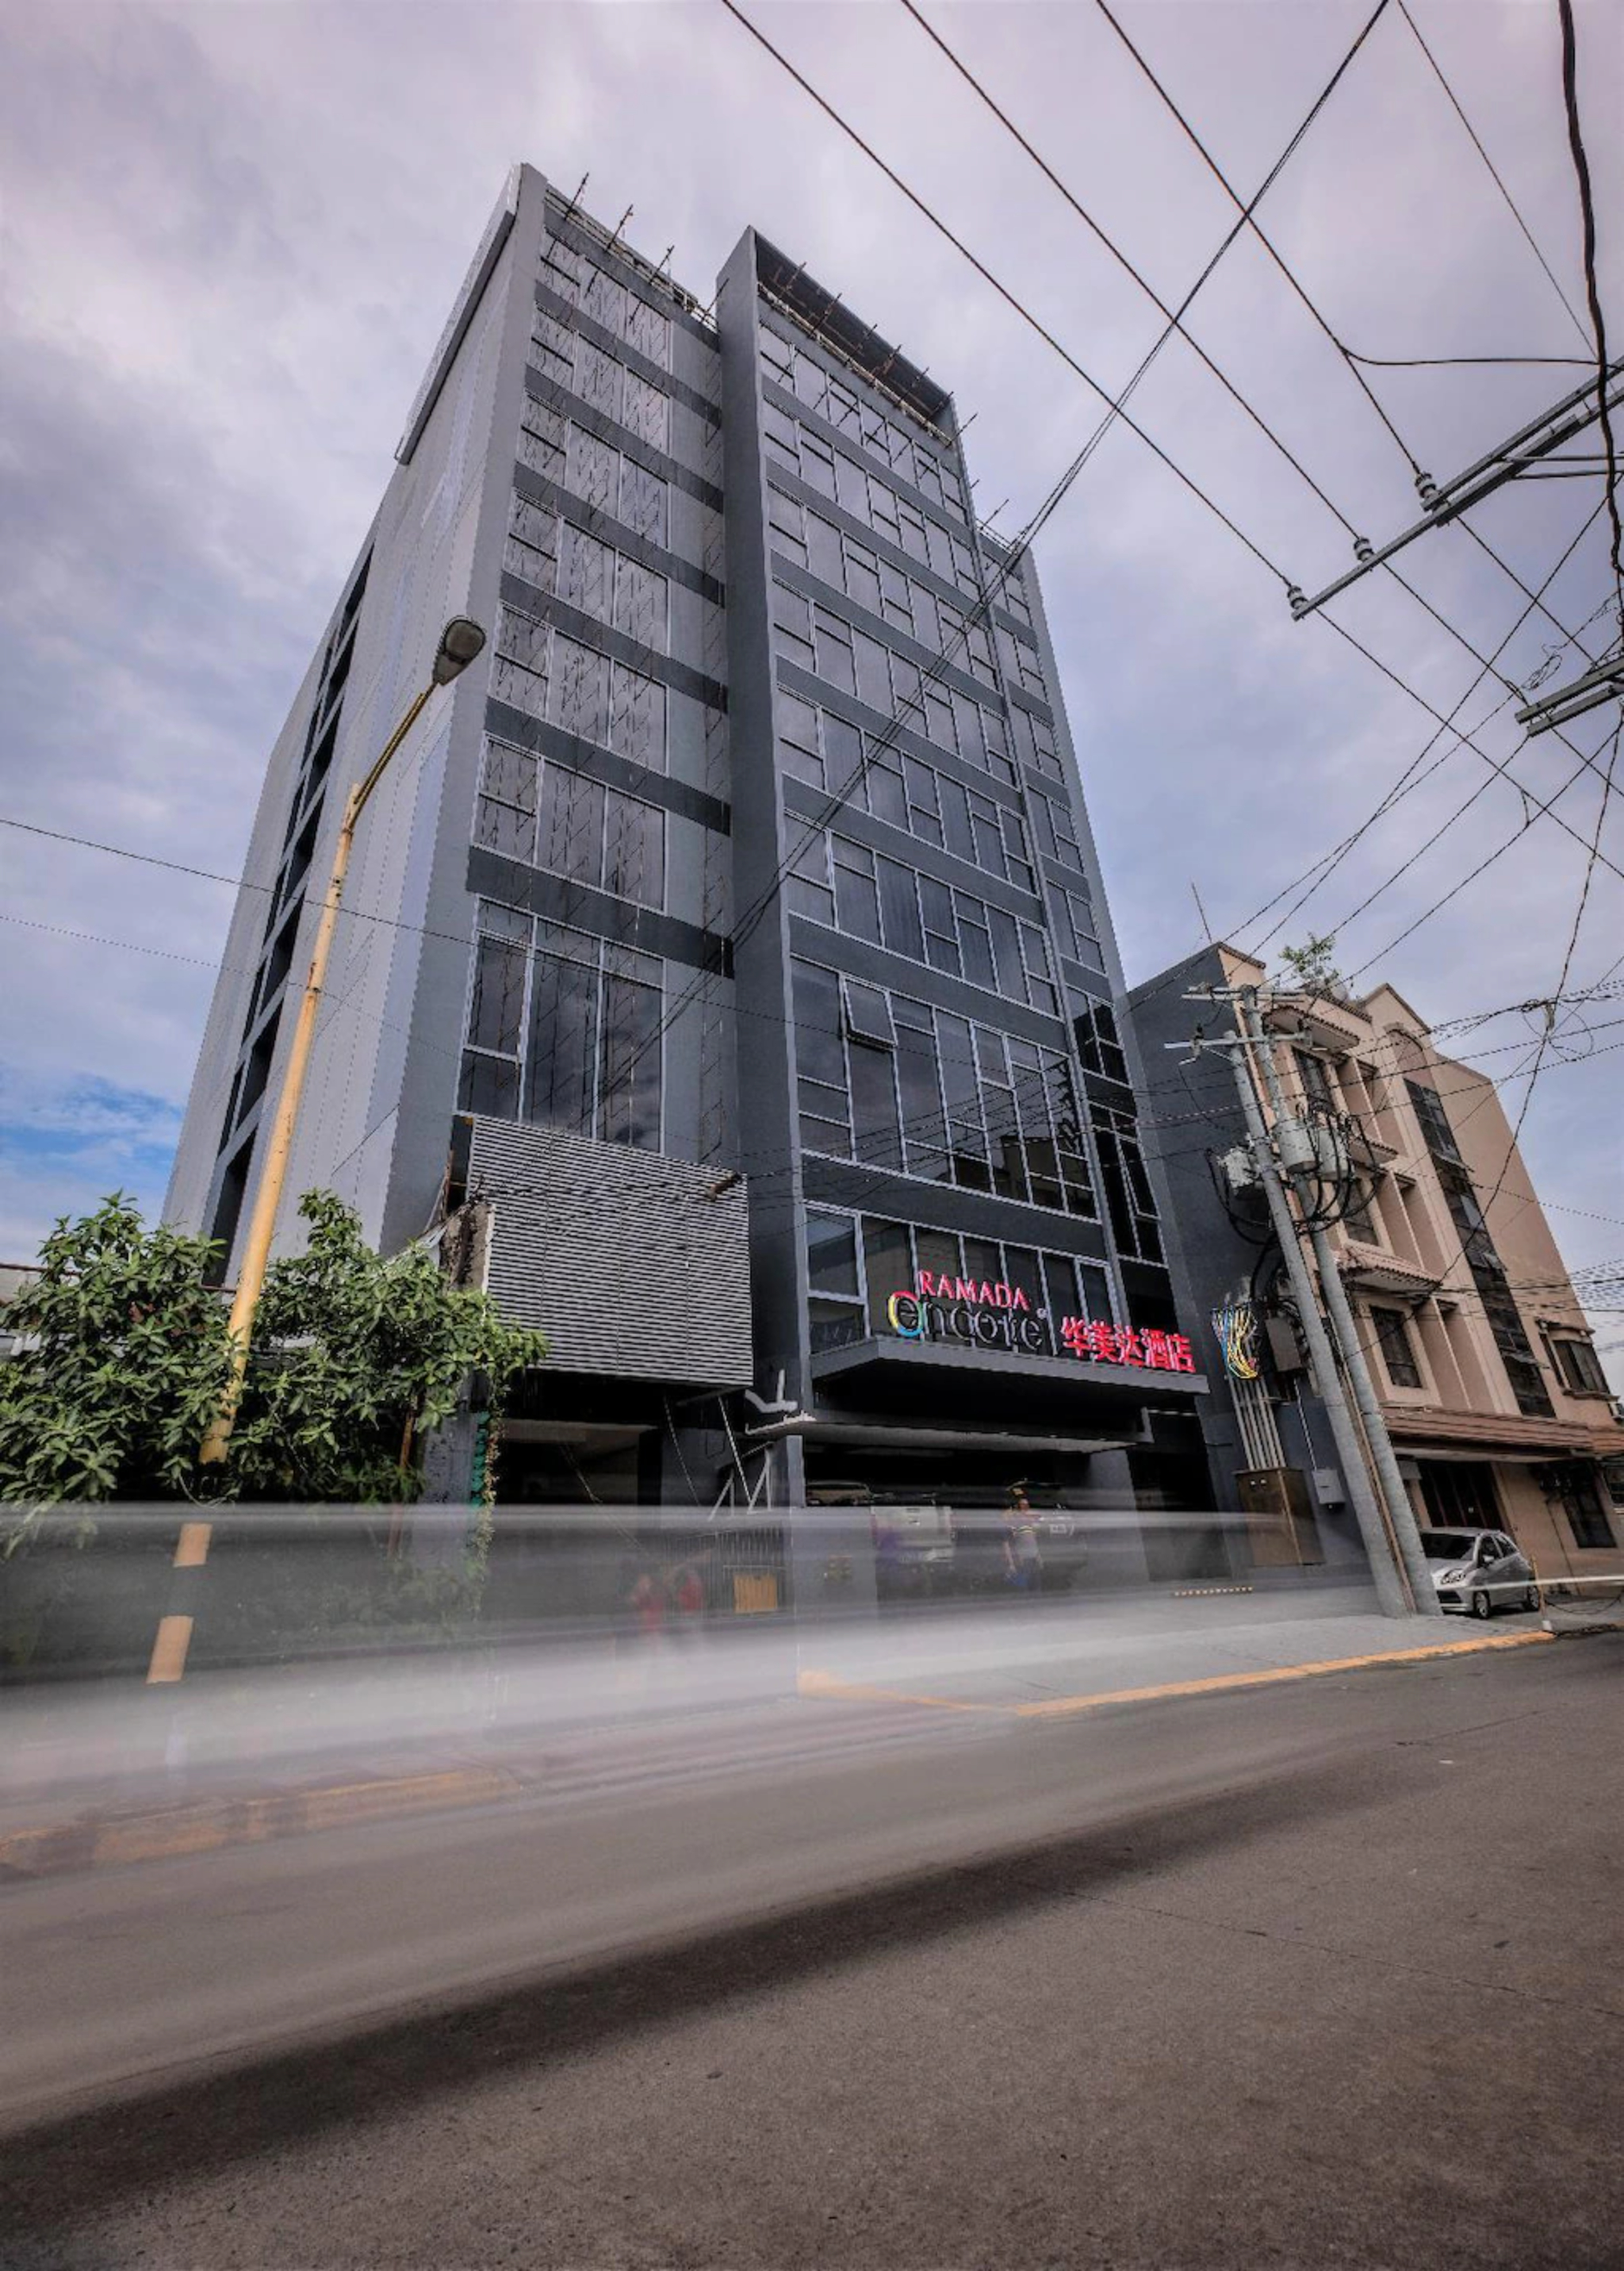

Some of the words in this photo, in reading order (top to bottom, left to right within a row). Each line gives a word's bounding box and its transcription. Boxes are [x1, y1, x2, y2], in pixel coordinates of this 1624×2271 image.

[918, 1270, 1030, 1311] RAMADA
[1060, 1316, 1197, 1373] 华美达酒店
